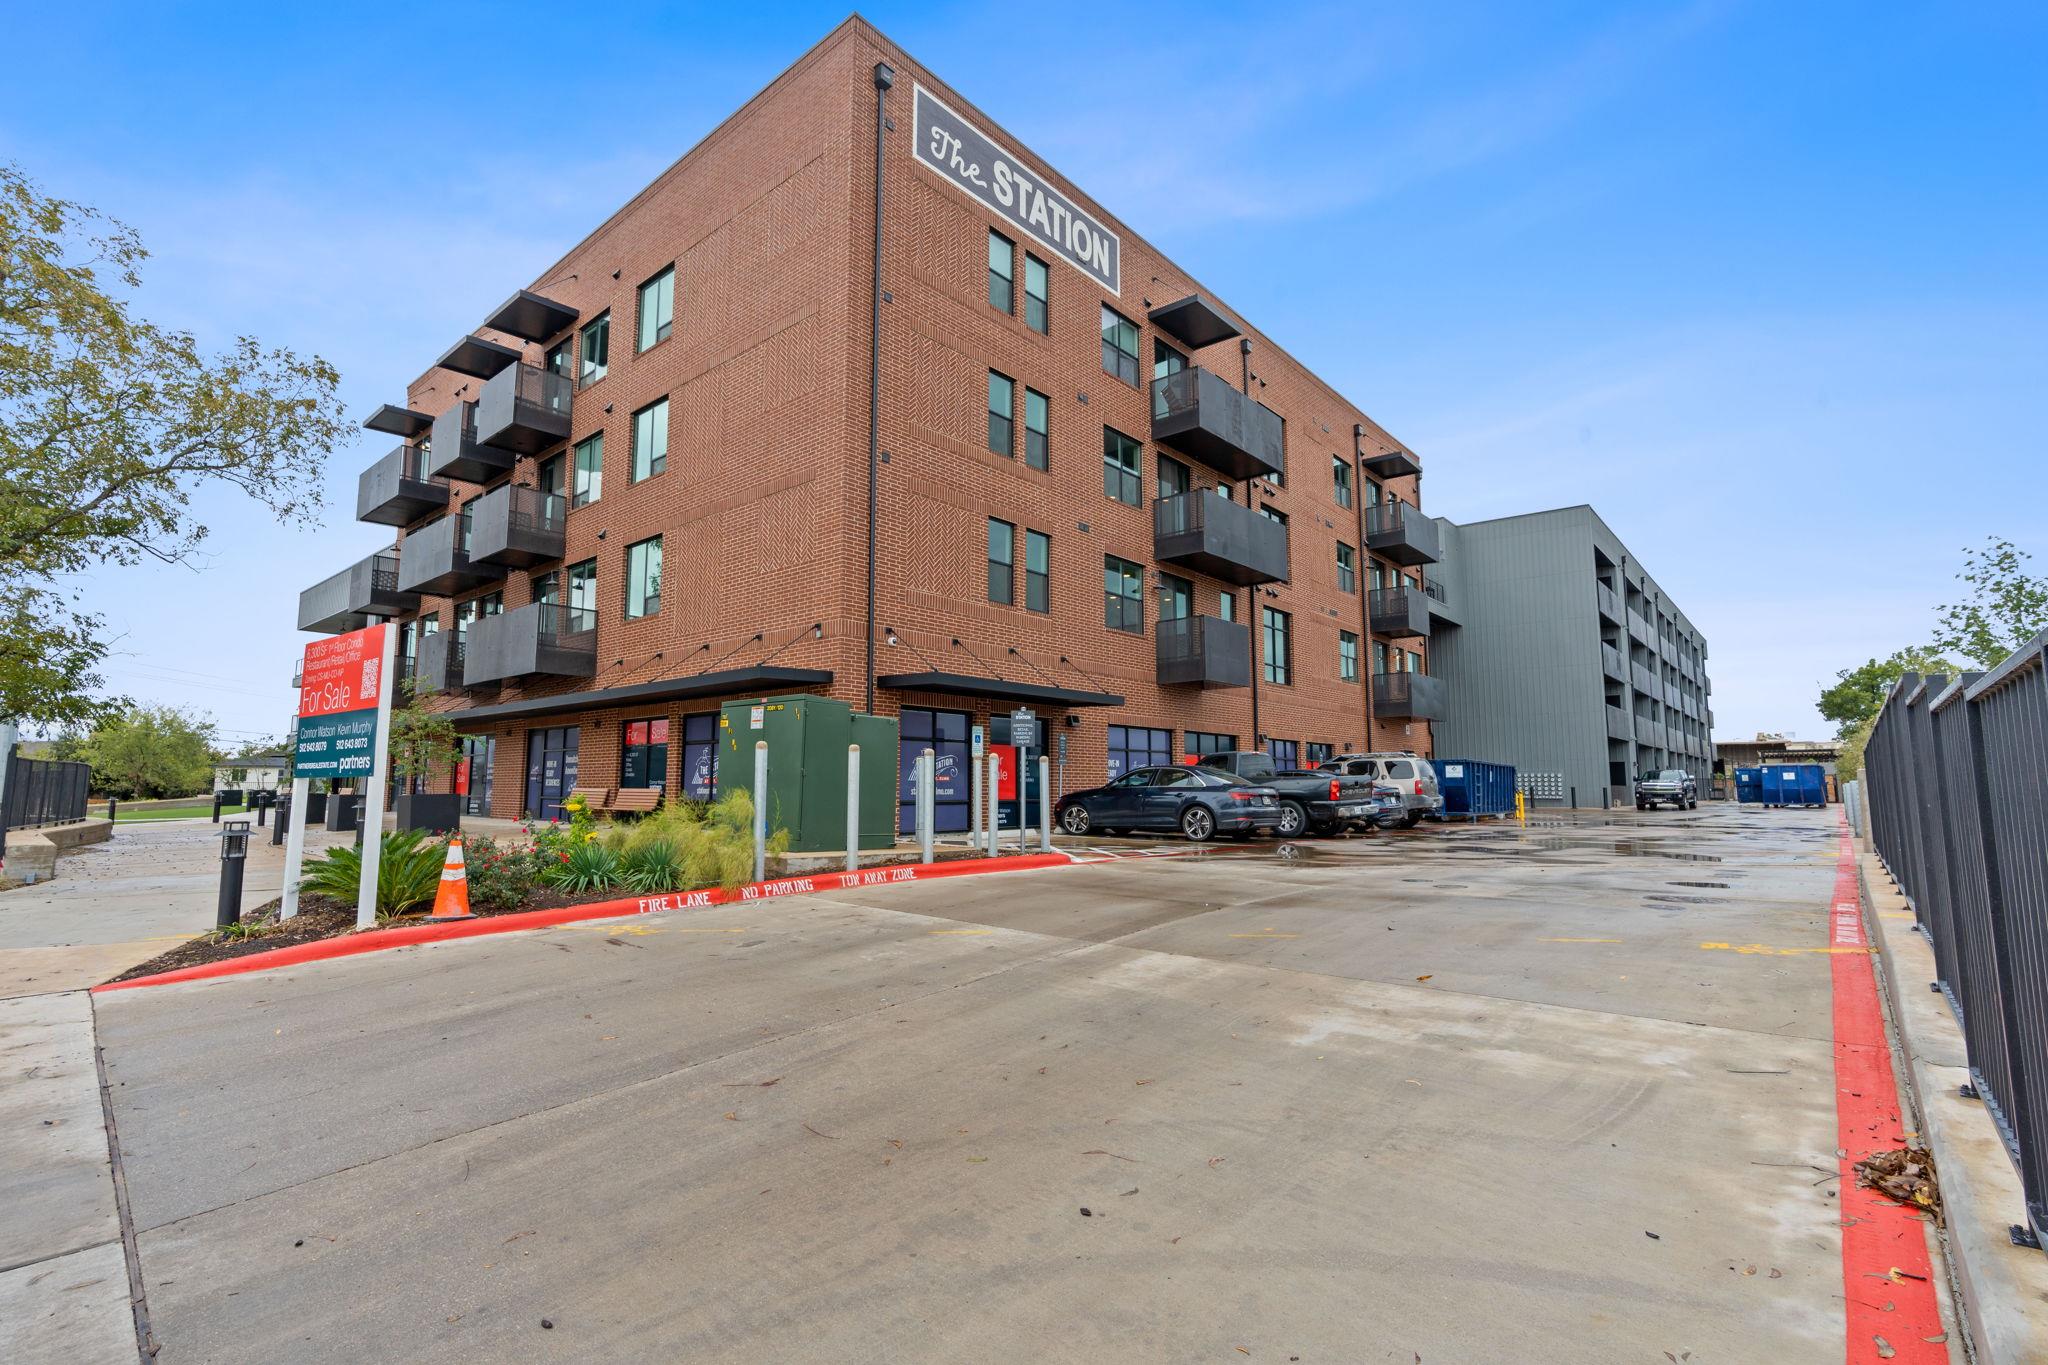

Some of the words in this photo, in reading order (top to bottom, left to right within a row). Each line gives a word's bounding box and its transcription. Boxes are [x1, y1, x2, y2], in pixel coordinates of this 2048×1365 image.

[930, 126, 988, 189] The
[992, 160, 1110, 277] STATION
[347, 637, 364, 650] Condo
[302, 686, 323, 713] For
[323, 681, 350, 710] Sale
[300, 727, 317, 739] Connor
[318, 725, 336, 737] Watson
[337, 722, 351, 735] Kevin
[352, 720, 372, 735] Murphy
[627, 729, 638, 741] For
[651, 727, 668, 739] Sale
[339, 754, 371, 774] partners
[700, 765, 709, 775] THE
[456, 773, 466, 783] Sale
[838, 874, 860, 888] TOW
[864, 870, 888, 885] AWAY
[891, 866, 918, 881] ZONE
[741, 887, 759, 900] NO
[764, 879, 815, 898] PARKING
[639, 897, 671, 914] FIRE
[676, 892, 712, 909] LANE
